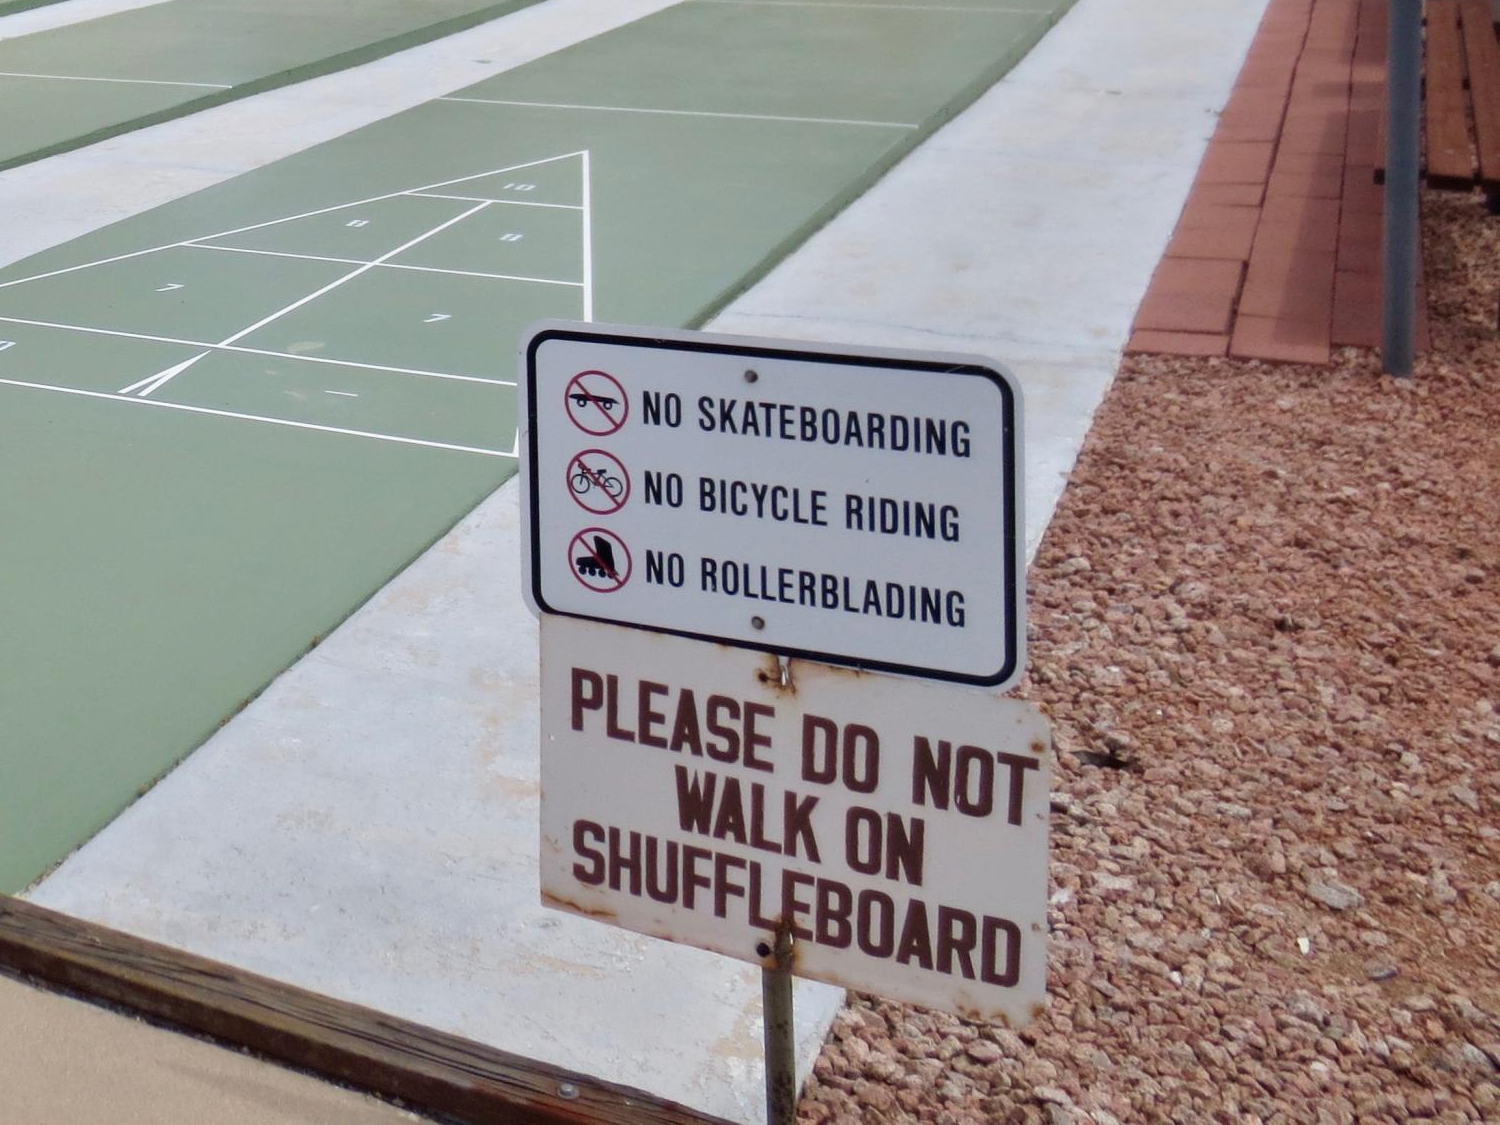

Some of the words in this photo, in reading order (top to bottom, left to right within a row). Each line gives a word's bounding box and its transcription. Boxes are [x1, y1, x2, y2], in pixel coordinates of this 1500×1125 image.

[642, 390, 682, 428] NO
[697, 395, 971, 458] SKATEBOARDING
[644, 470, 683, 508] NO
[699, 476, 828, 527] BICYCLE
[845, 494, 960, 543] RIDING
[645, 549, 685, 588] NO
[700, 557, 965, 628] ROLLERBLADING
[571, 667, 775, 773] PLEASE
[801, 714, 880, 794] DO
[912, 736, 1040, 826] NOT
[674, 764, 821, 864] WALK
[845, 806, 925, 887] ON
[572, 819, 1022, 988] SHUFFLEBOARD
